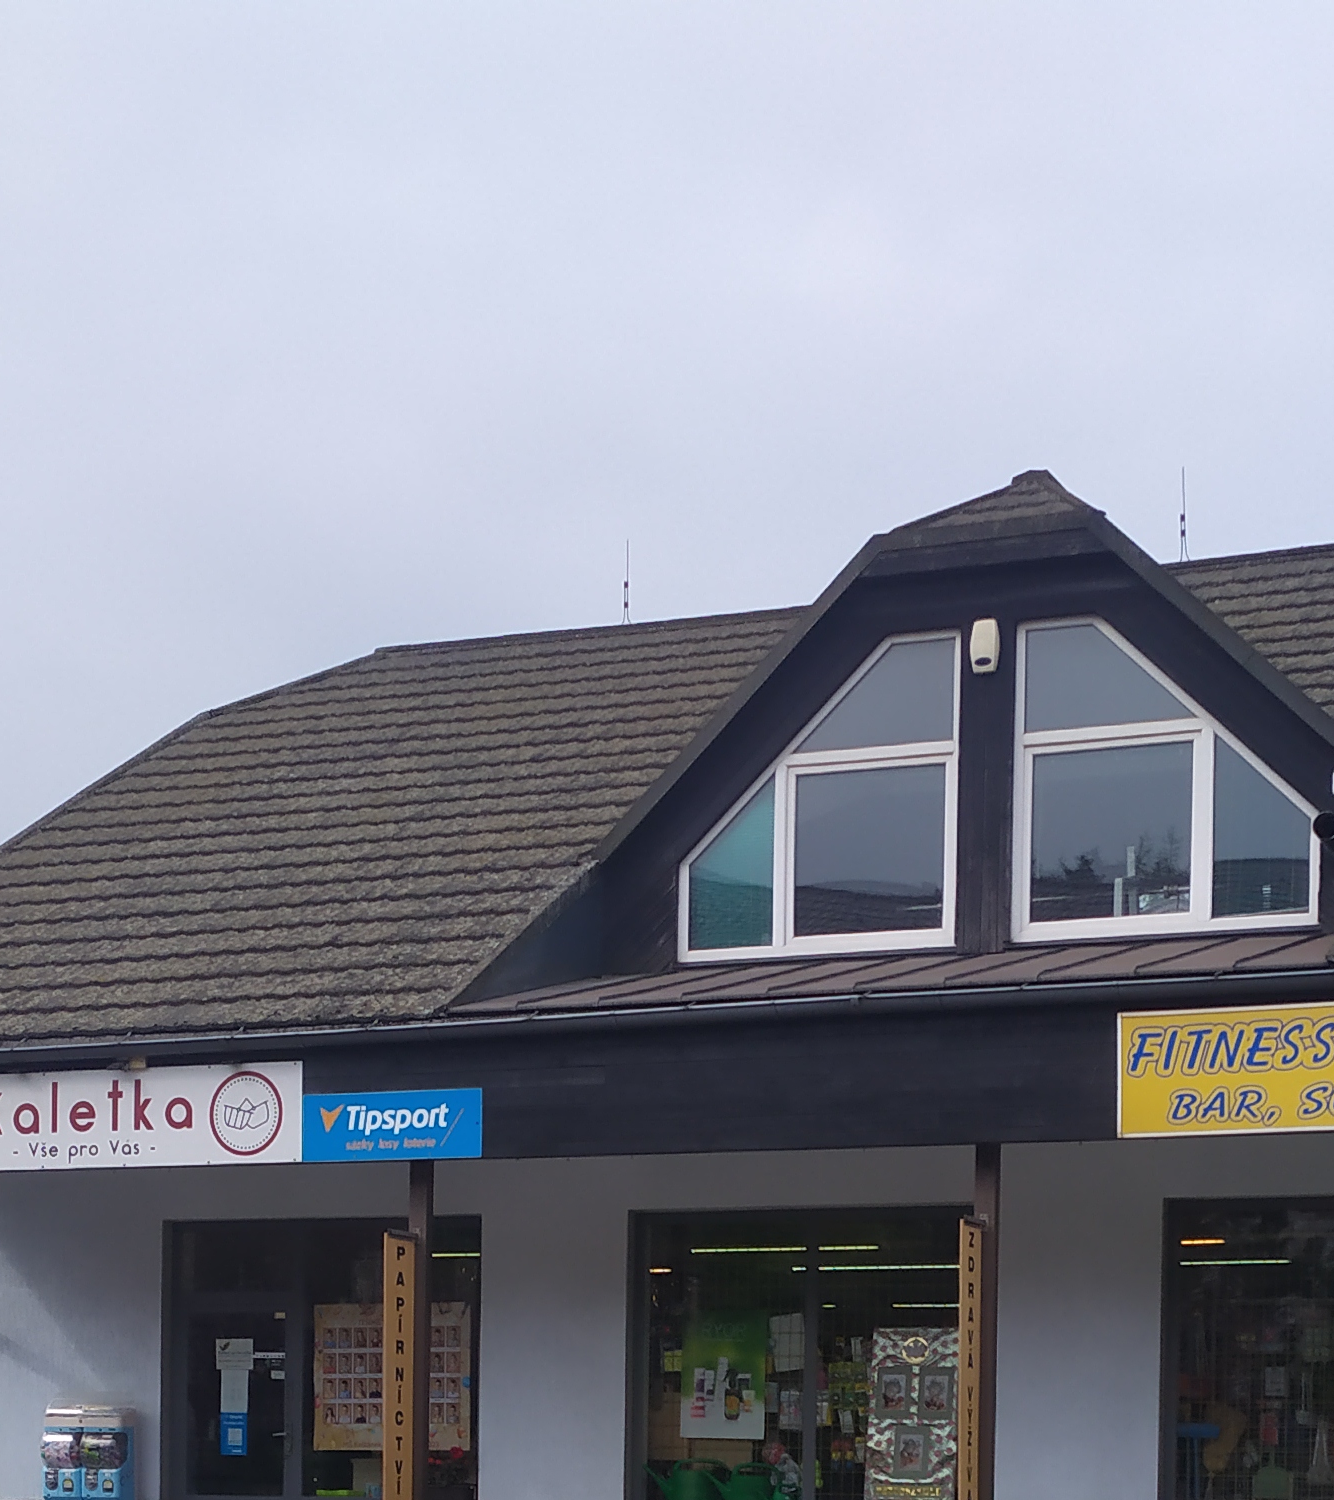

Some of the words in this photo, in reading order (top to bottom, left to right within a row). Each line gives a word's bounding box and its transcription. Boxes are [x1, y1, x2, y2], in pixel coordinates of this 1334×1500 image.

[346, 1103, 450, 1136] Tipsport
[1169, 1088, 1280, 1125] BAR,
[28, 1141, 59, 1158] Vše
[68, 1143, 99, 1164] pro
[109, 1139, 141, 1156] Vás
[966, 1231, 976, 1370] ZDRAVÁ
